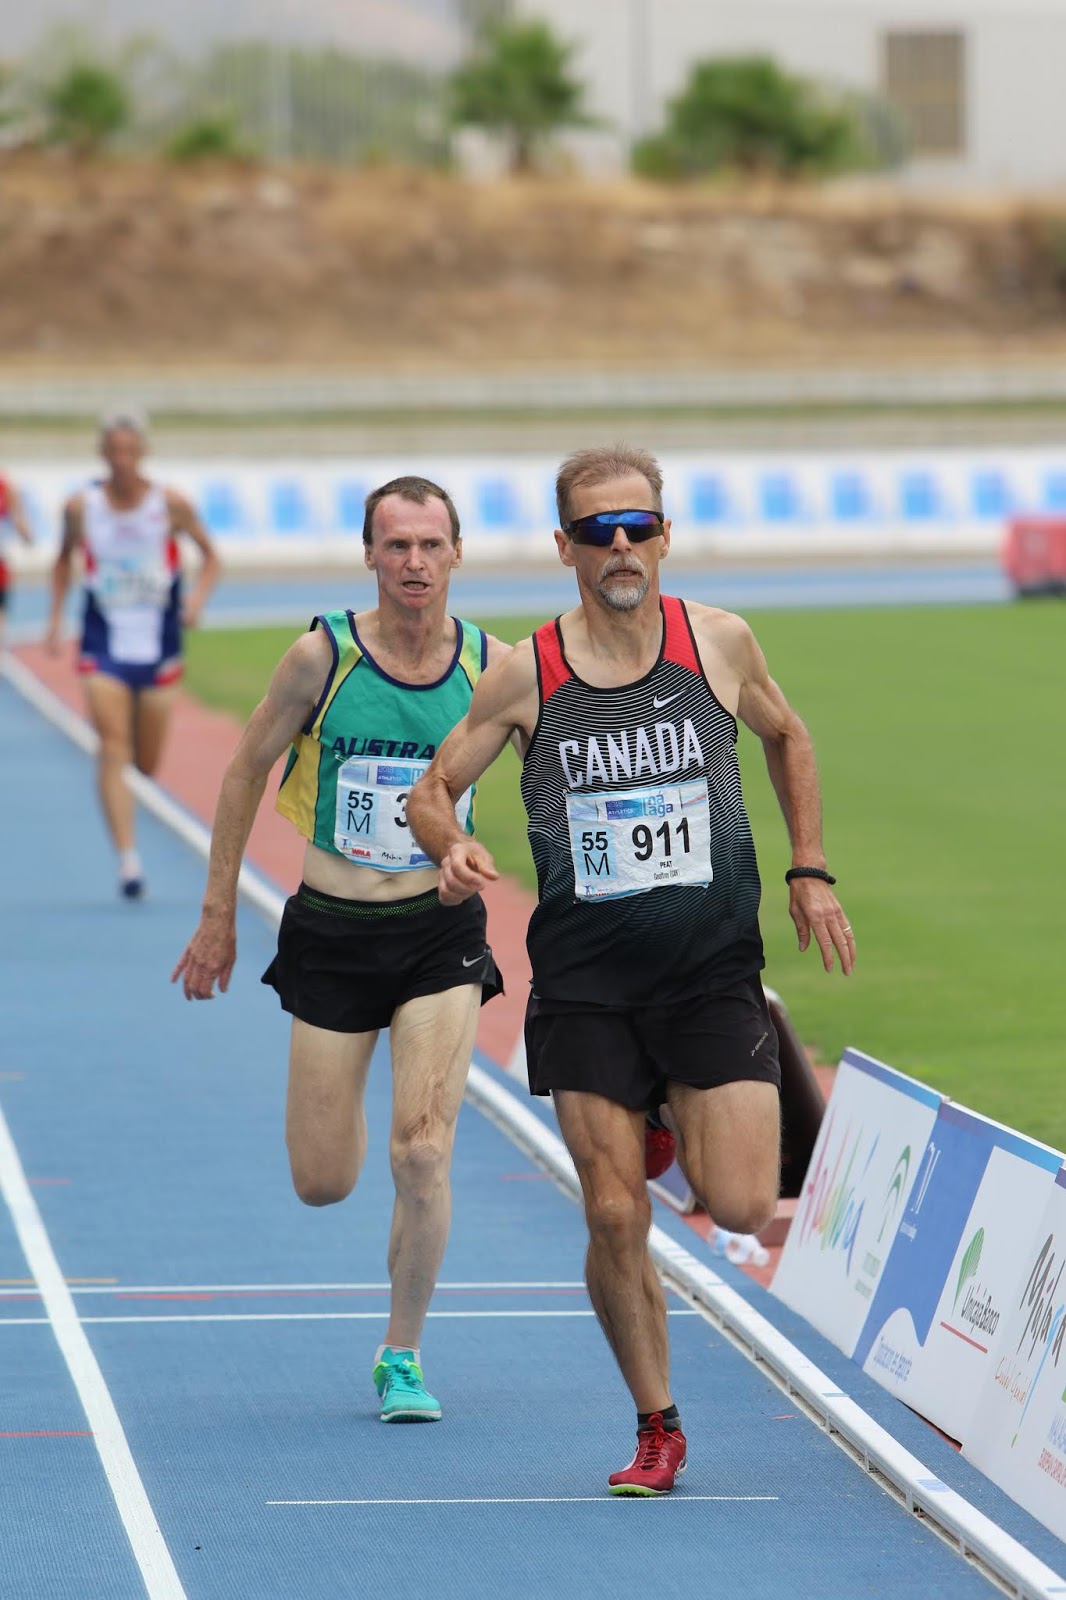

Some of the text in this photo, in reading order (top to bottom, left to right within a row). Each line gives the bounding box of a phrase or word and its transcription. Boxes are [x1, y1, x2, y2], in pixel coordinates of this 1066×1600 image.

[559, 718, 705, 788] CANADA
[347, 791, 374, 811] 55
[347, 810, 371, 834] M
[581, 817, 690, 861] 55 911
[352, 848, 371, 858] WMA
[584, 853, 611, 876] M
[660, 860, 673, 869] PEAT
